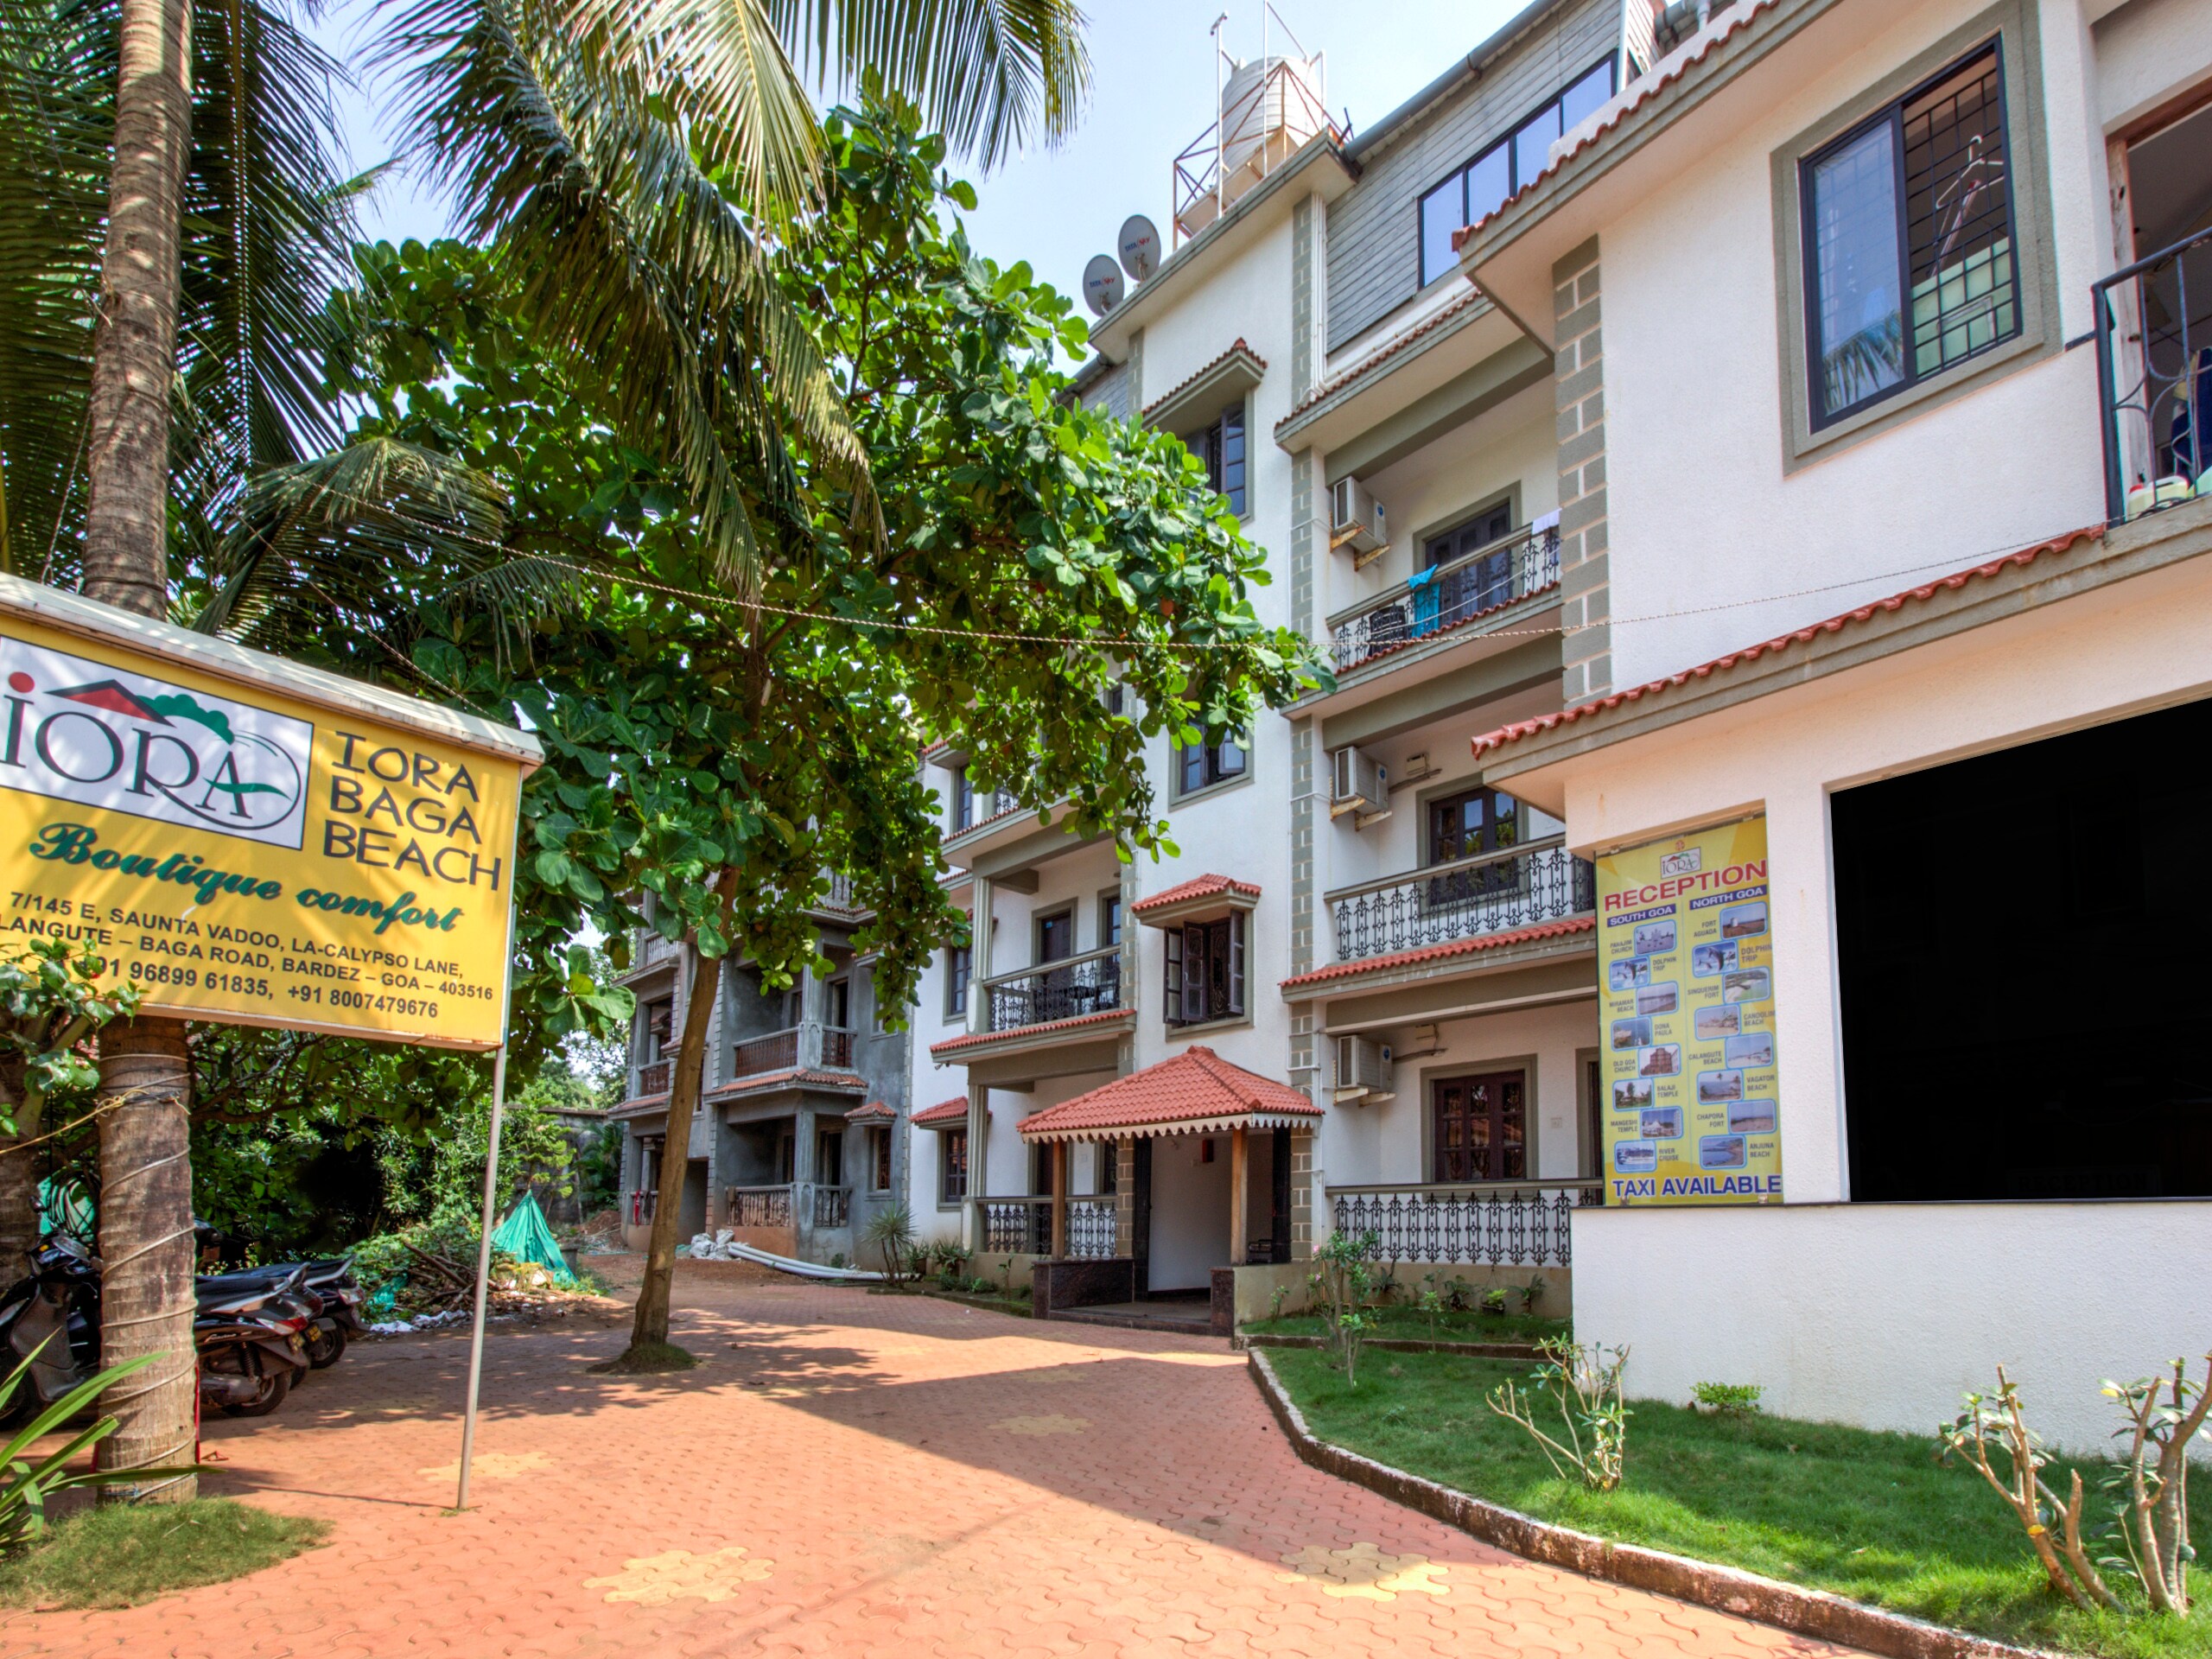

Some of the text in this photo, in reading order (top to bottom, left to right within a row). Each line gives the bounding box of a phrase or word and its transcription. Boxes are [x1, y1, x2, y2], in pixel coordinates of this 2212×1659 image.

[332, 731, 480, 803] IORA
[330, 774, 482, 844] BAGA
[323, 819, 501, 891] BEACH
[29, 823, 464, 935] Boutique comfort
[1604, 860, 1767, 912] RECEPTION
[1692, 887, 1764, 908] NORTH GOA
[1610, 906, 1673, 926] SOUTH GOA
[10, 892, 464, 979] 7/145 E, SAUNTA VADOO, LA-CALYPSO LANE,
[1611, 945, 1632, 955] CHURCH
[1652, 956, 1676, 965] DOLPHIN
[1741, 954, 1758, 963] TRIP
[140, 936, 203, 959] BAGA
[210, 946, 275, 972] ROAD,
[282, 957, 360, 982] BARDEZ
[381, 973, 419, 990] GOA
[439, 982, 493, 1001] 403516
[130, 962, 198, 987] 96899
[205, 972, 274, 1001] 61835,
[288, 985, 321, 1003] +91
[330, 989, 438, 1018] 8007479676
[1744, 1018, 1764, 1027] BEACH
[1688, 1051, 1722, 1060] CALANGUTE
[1614, 1065, 1636, 1073] CHURCH
[1746, 1074, 1775, 1083] VAGATOR
[1696, 1112, 1724, 1121] CHAPORA
[1613, 1174, 1782, 1197] TAXI AVAILABLE
